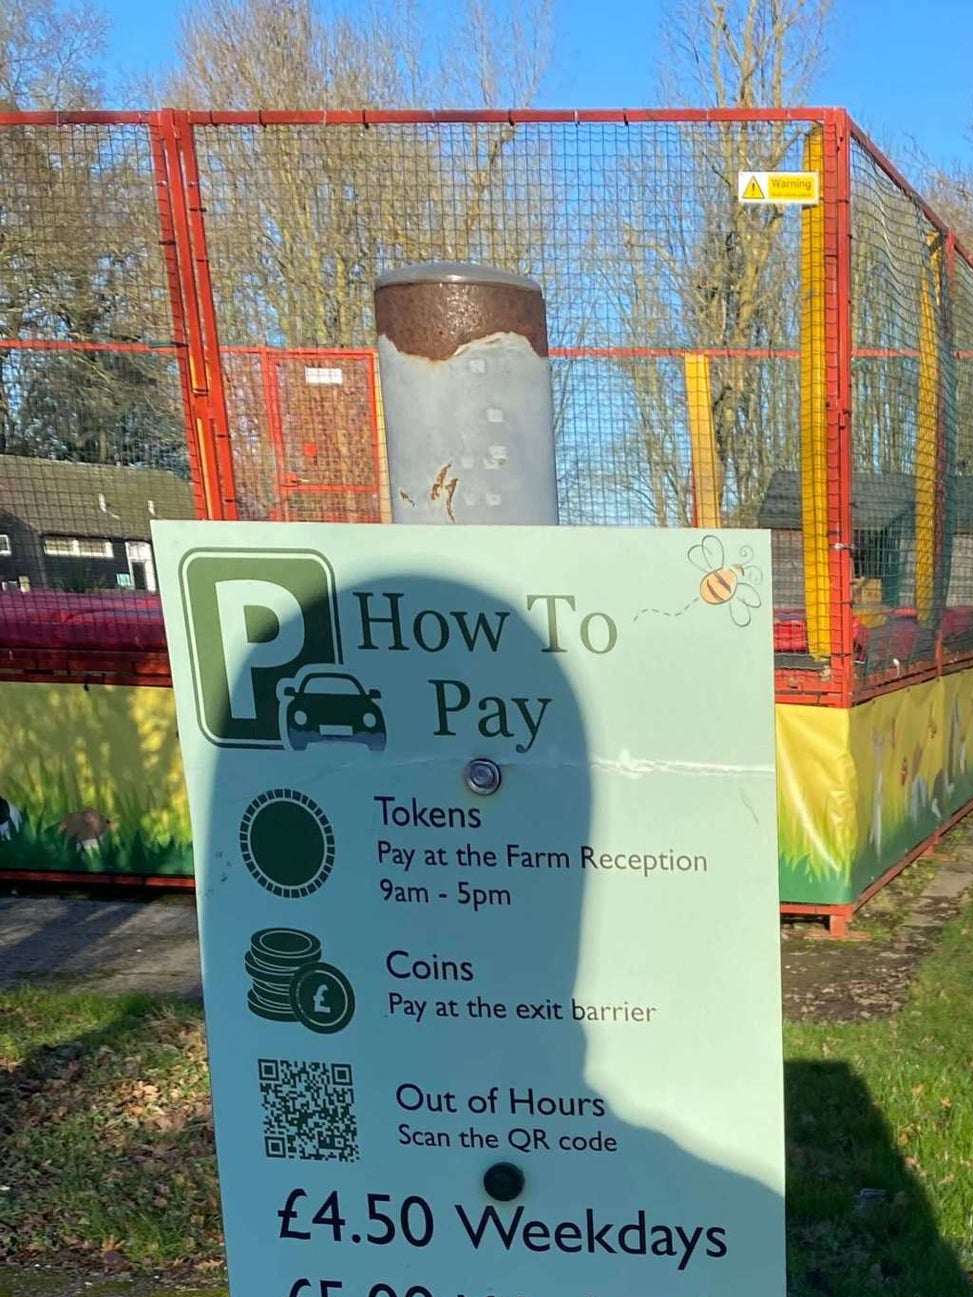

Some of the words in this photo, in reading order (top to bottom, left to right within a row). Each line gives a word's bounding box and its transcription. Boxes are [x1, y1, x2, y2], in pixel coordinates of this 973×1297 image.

[771, 178, 812, 191] Warning
[353, 592, 511, 654] How
[527, 594, 618, 655] To
[429, 679, 552, 753] Pay
[374, 795, 482, 829] Tokens
[377, 841, 416, 867] Pay
[425, 847, 448, 867] at
[456, 843, 497, 868] the
[507, 845, 570, 869] Farm
[581, 846, 708, 878] Reception
[379, 880, 429, 903] 9am
[457, 882, 512, 911] 5pm
[386, 951, 474, 982] Coins
[389, 993, 426, 1022] Pay
[433, 998, 457, 1019] at
[467, 995, 507, 1020] the
[516, 996, 562, 1021] exit
[572, 997, 656, 1023] barrier
[396, 1083, 457, 1115] Out
[468, 1084, 499, 1115] of
[510, 1087, 606, 1118] Hours
[399, 1124, 451, 1148] Scan
[459, 1127, 499, 1149] the
[508, 1129, 551, 1153] QR
[559, 1130, 617, 1152] code
[277, 1188, 434, 1247] £4.50
[454, 1204, 728, 1271] Weekdays
